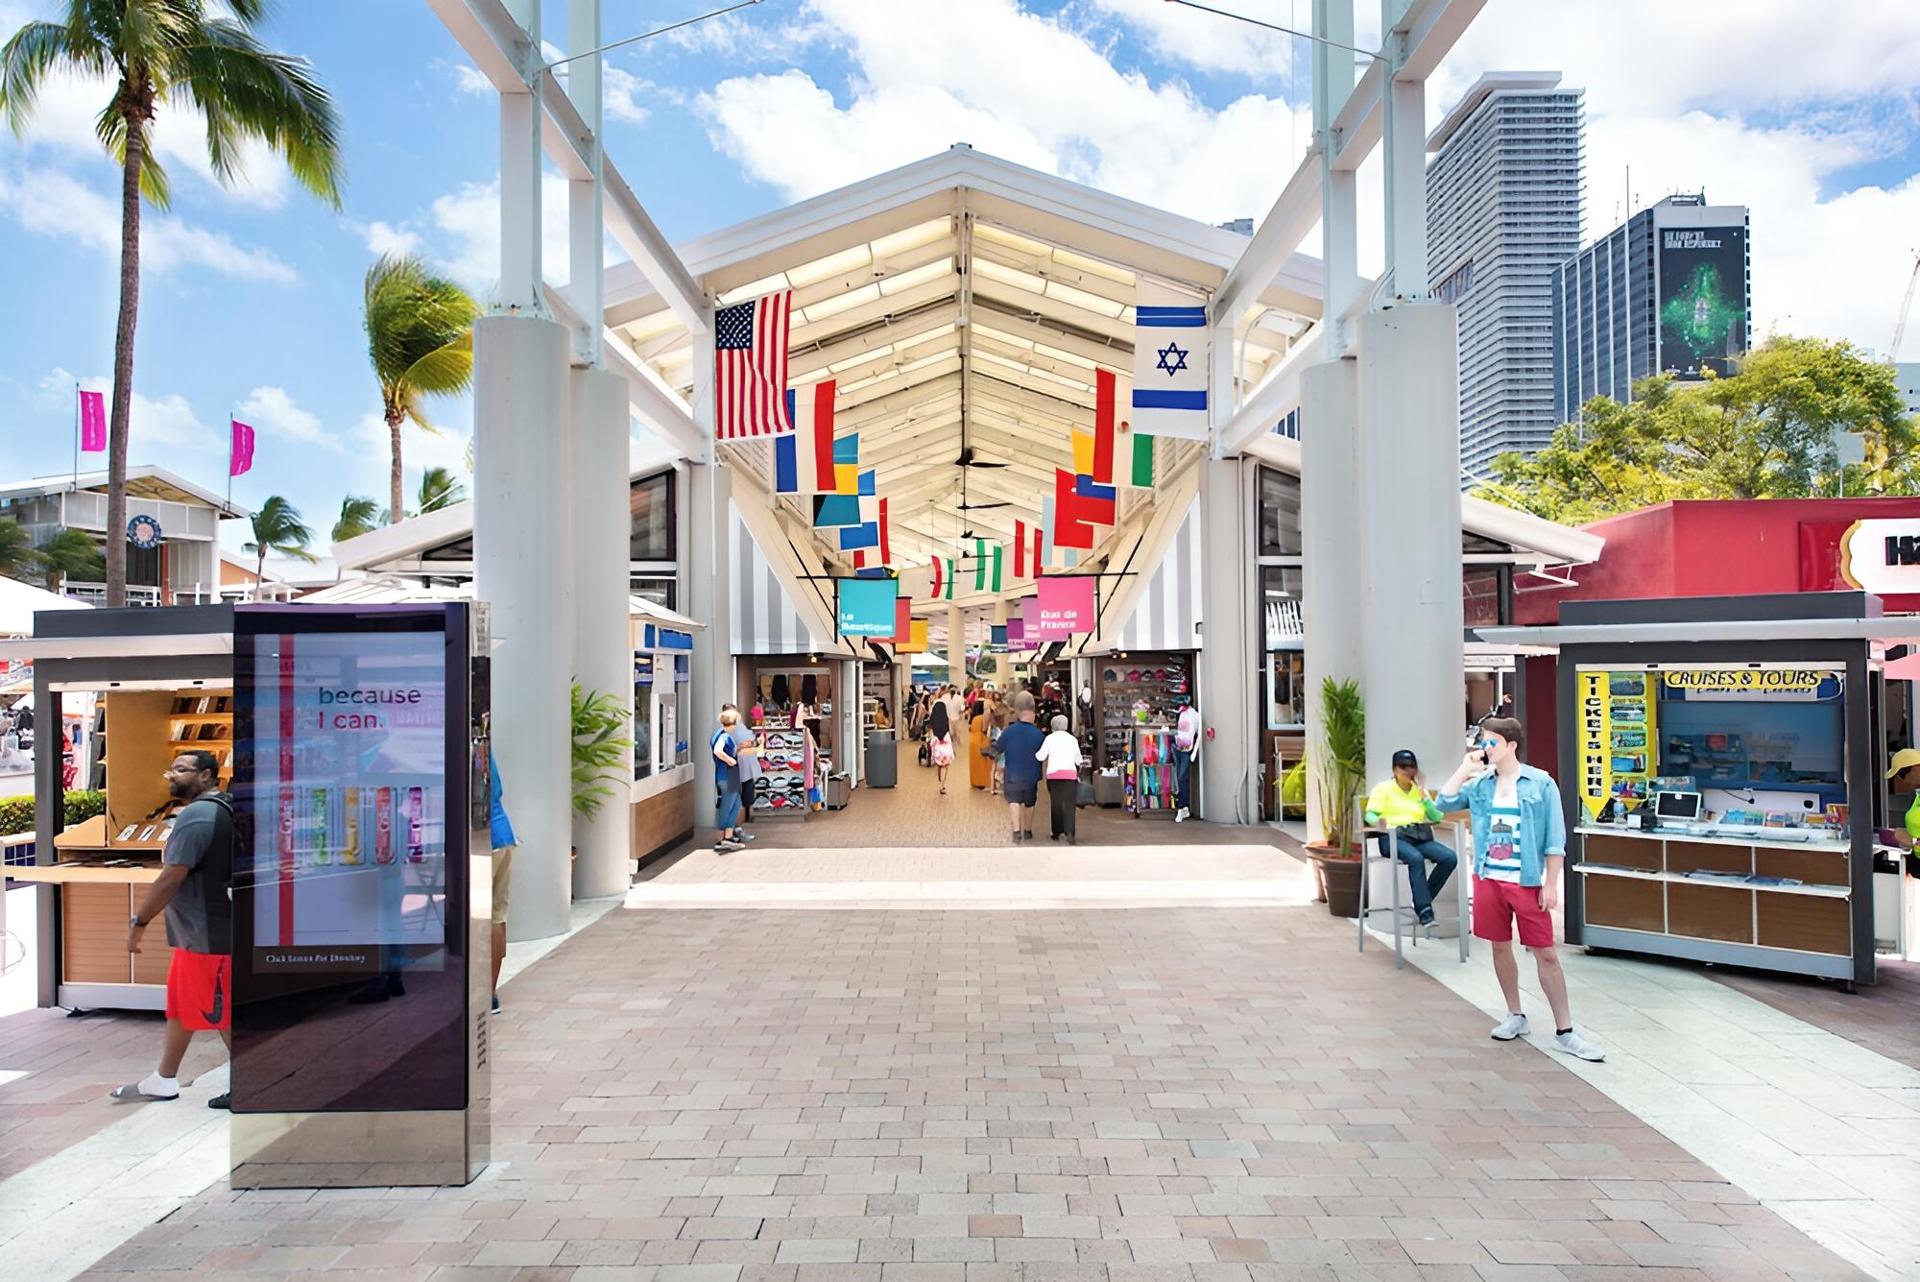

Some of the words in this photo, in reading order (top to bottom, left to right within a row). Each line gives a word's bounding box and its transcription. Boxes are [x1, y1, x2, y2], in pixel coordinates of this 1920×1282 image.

[1668, 670, 1736, 686] CRUISES
[1759, 670, 1820, 686] TOURS
[319, 686, 422, 704] because
[318, 711, 324, 729] I
[334, 714, 384, 729] can.
